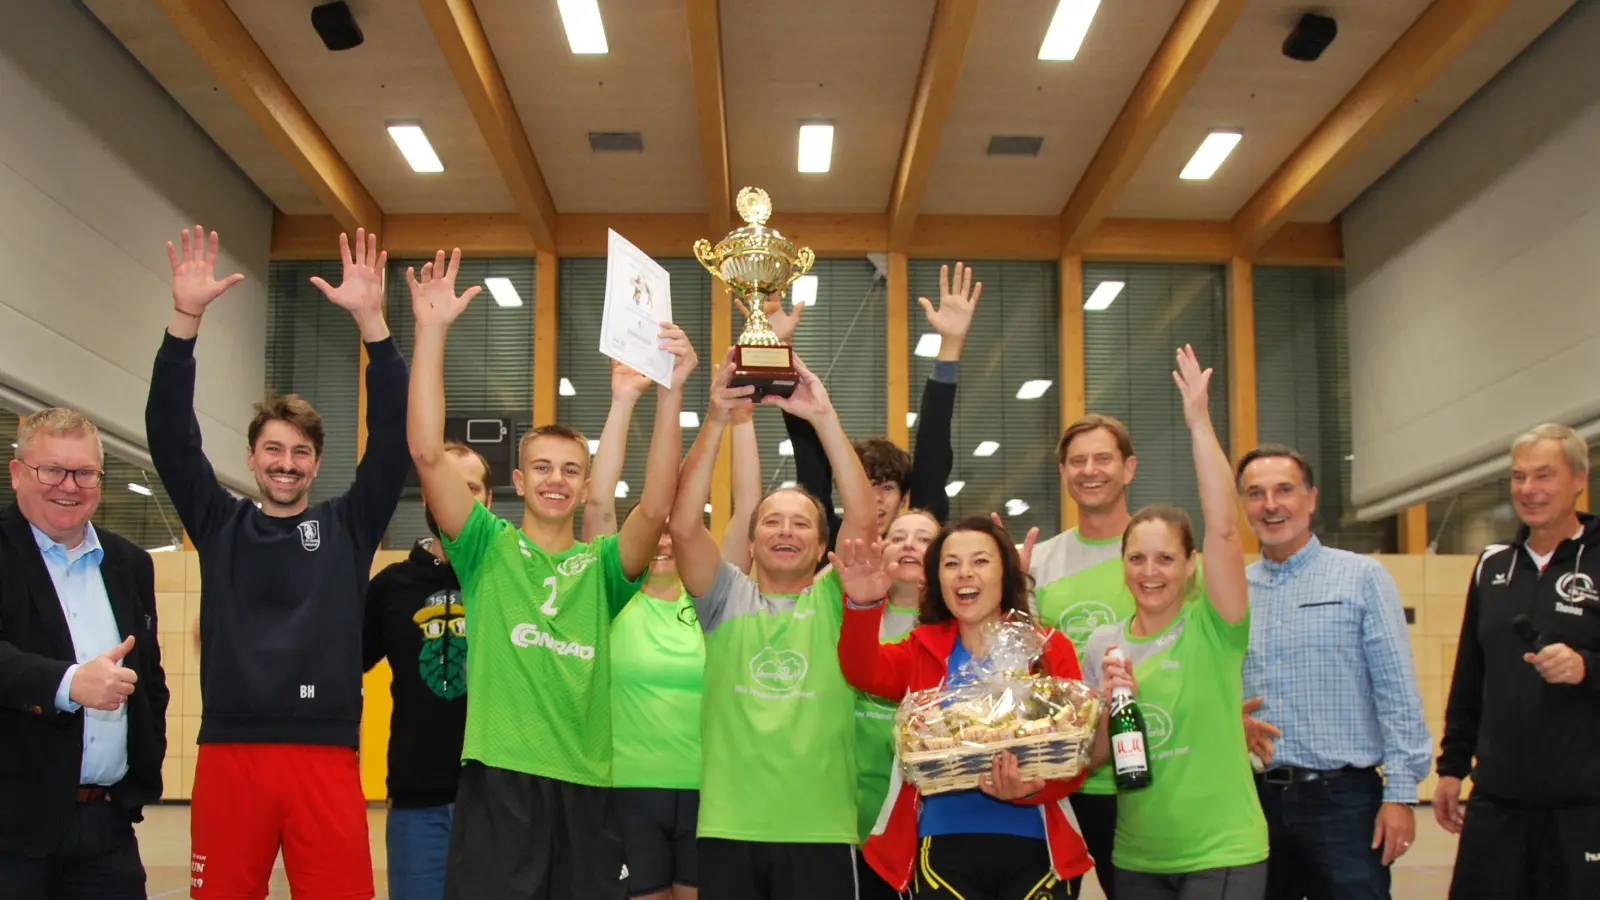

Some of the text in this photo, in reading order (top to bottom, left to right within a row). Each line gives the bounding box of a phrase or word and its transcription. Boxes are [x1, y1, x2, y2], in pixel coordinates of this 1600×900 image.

[540, 576, 558, 615] 2
[510, 622, 595, 659] CONRAD
[300, 684, 315, 698] BH
